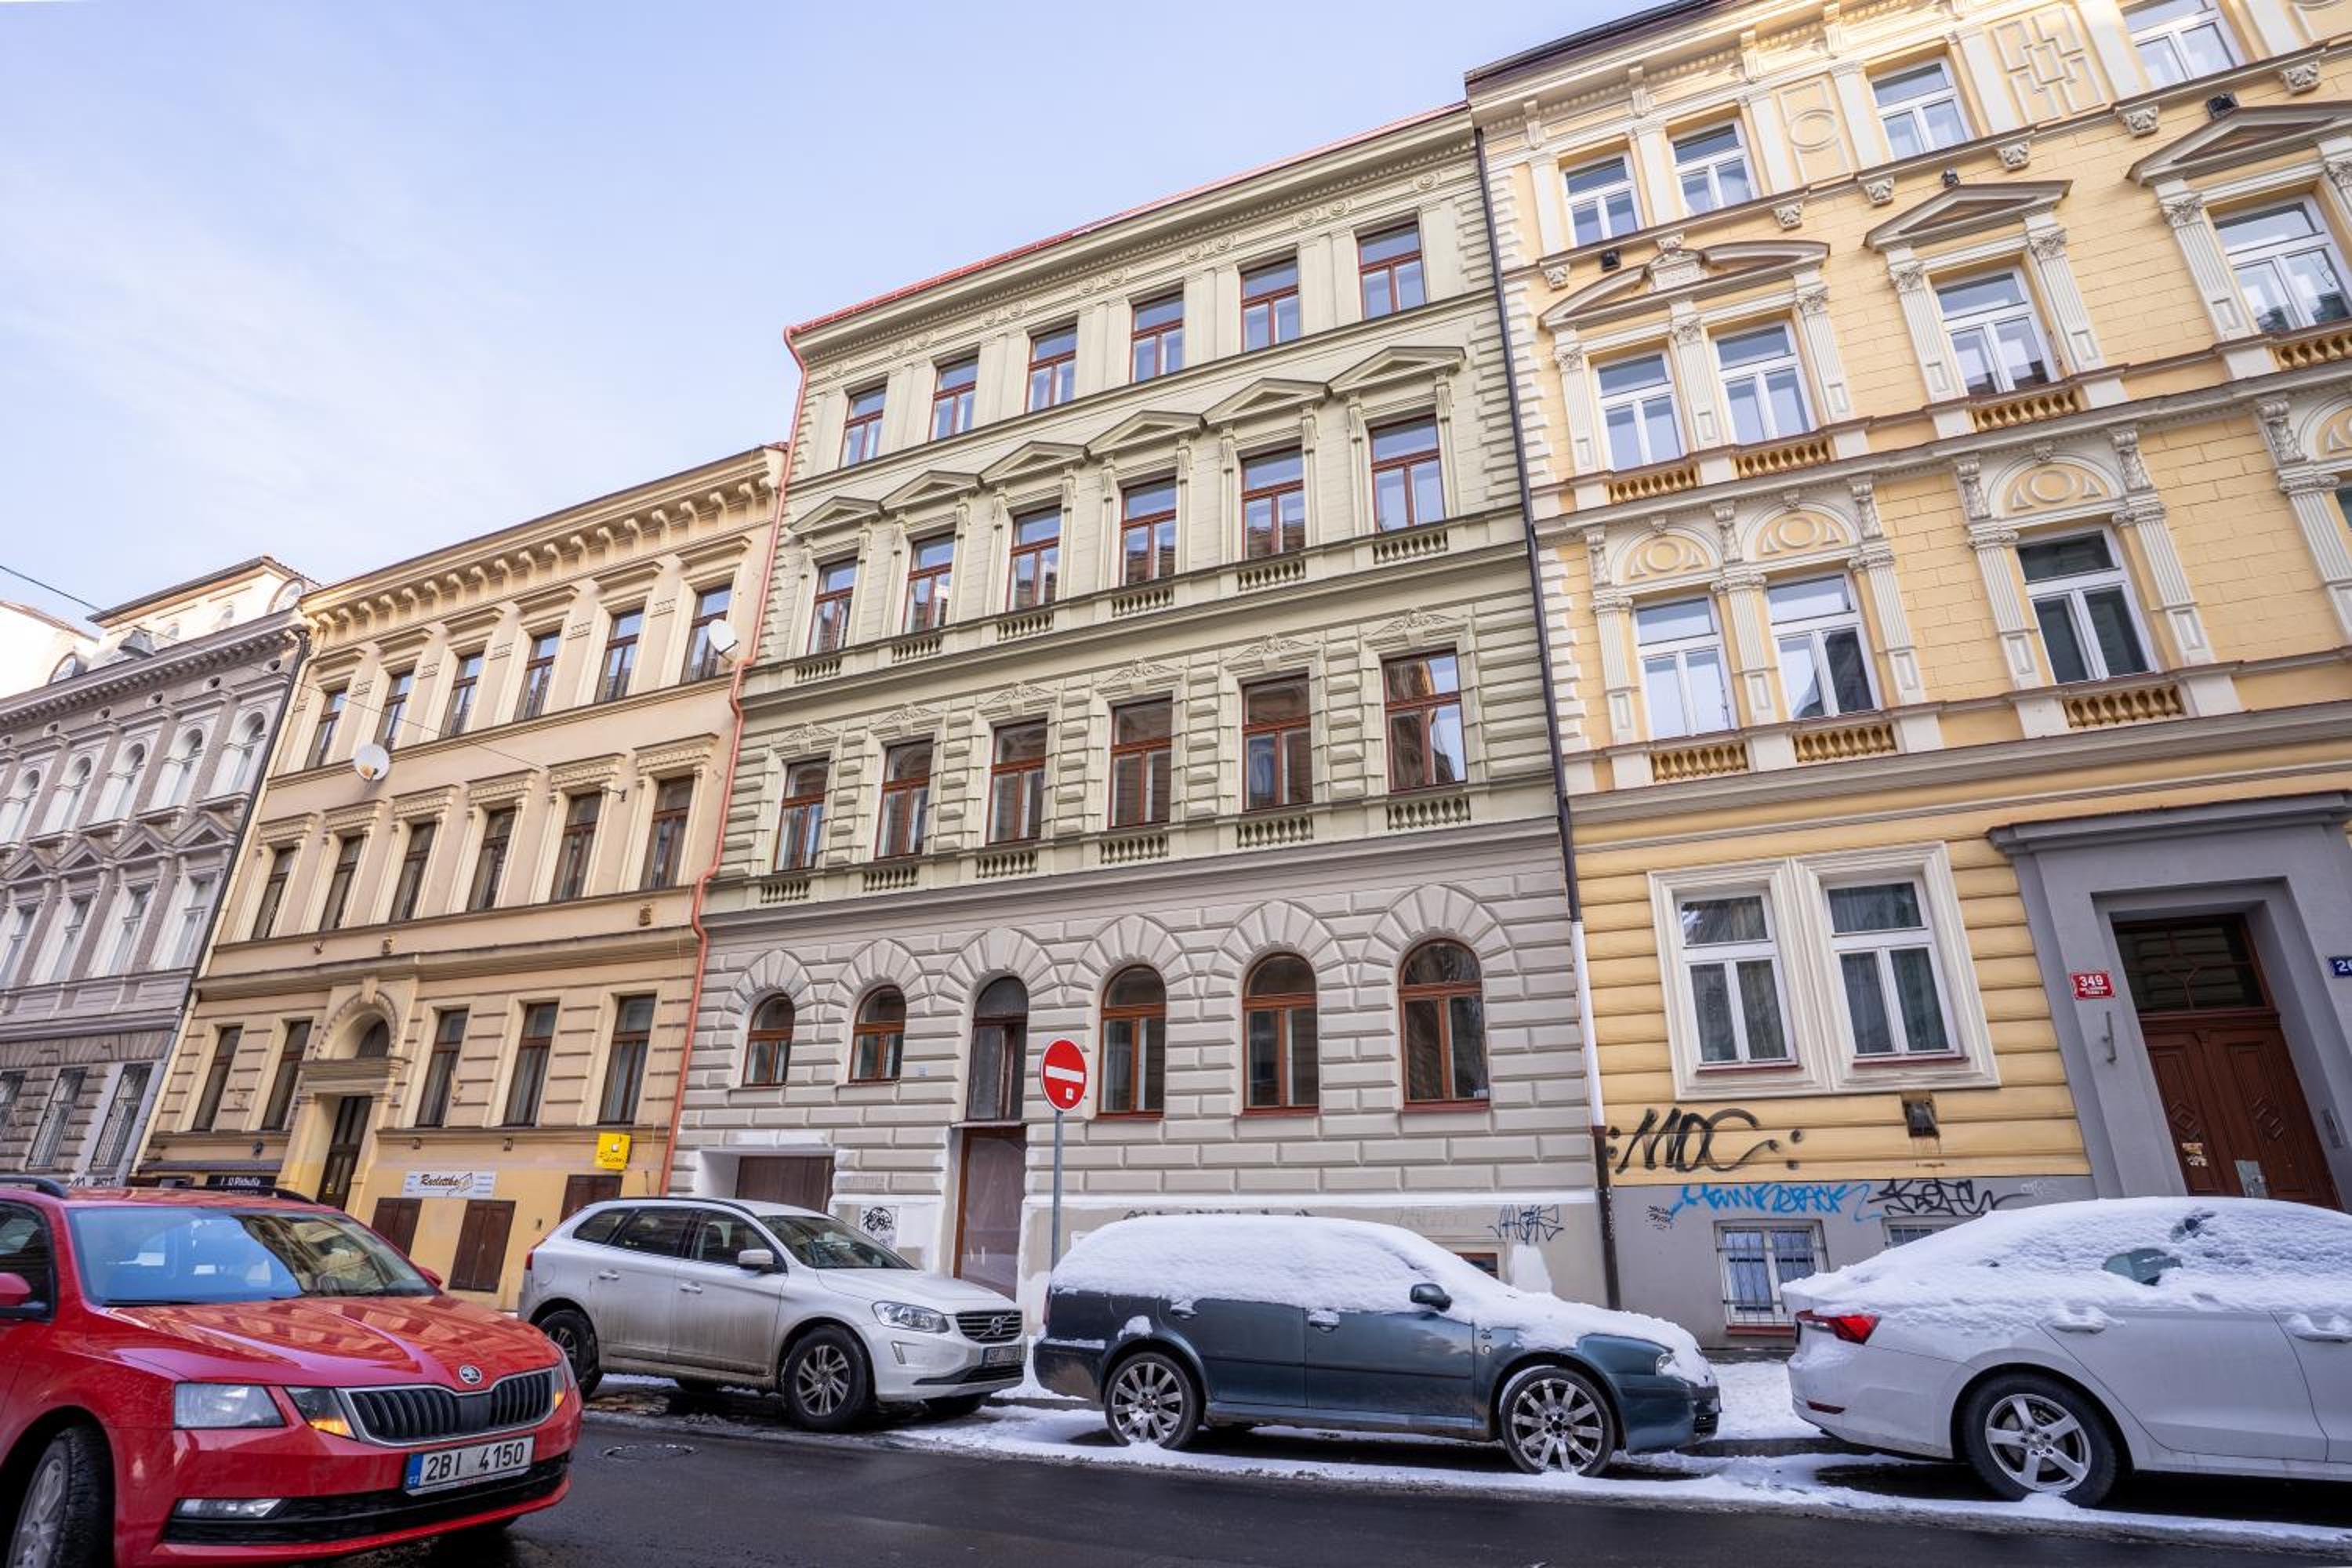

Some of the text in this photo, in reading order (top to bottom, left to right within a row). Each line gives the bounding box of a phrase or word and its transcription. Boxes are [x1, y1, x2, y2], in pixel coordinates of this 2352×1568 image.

[2079, 975, 2103, 987] 349
[426, 1442, 525, 1481] 2BI 4150
